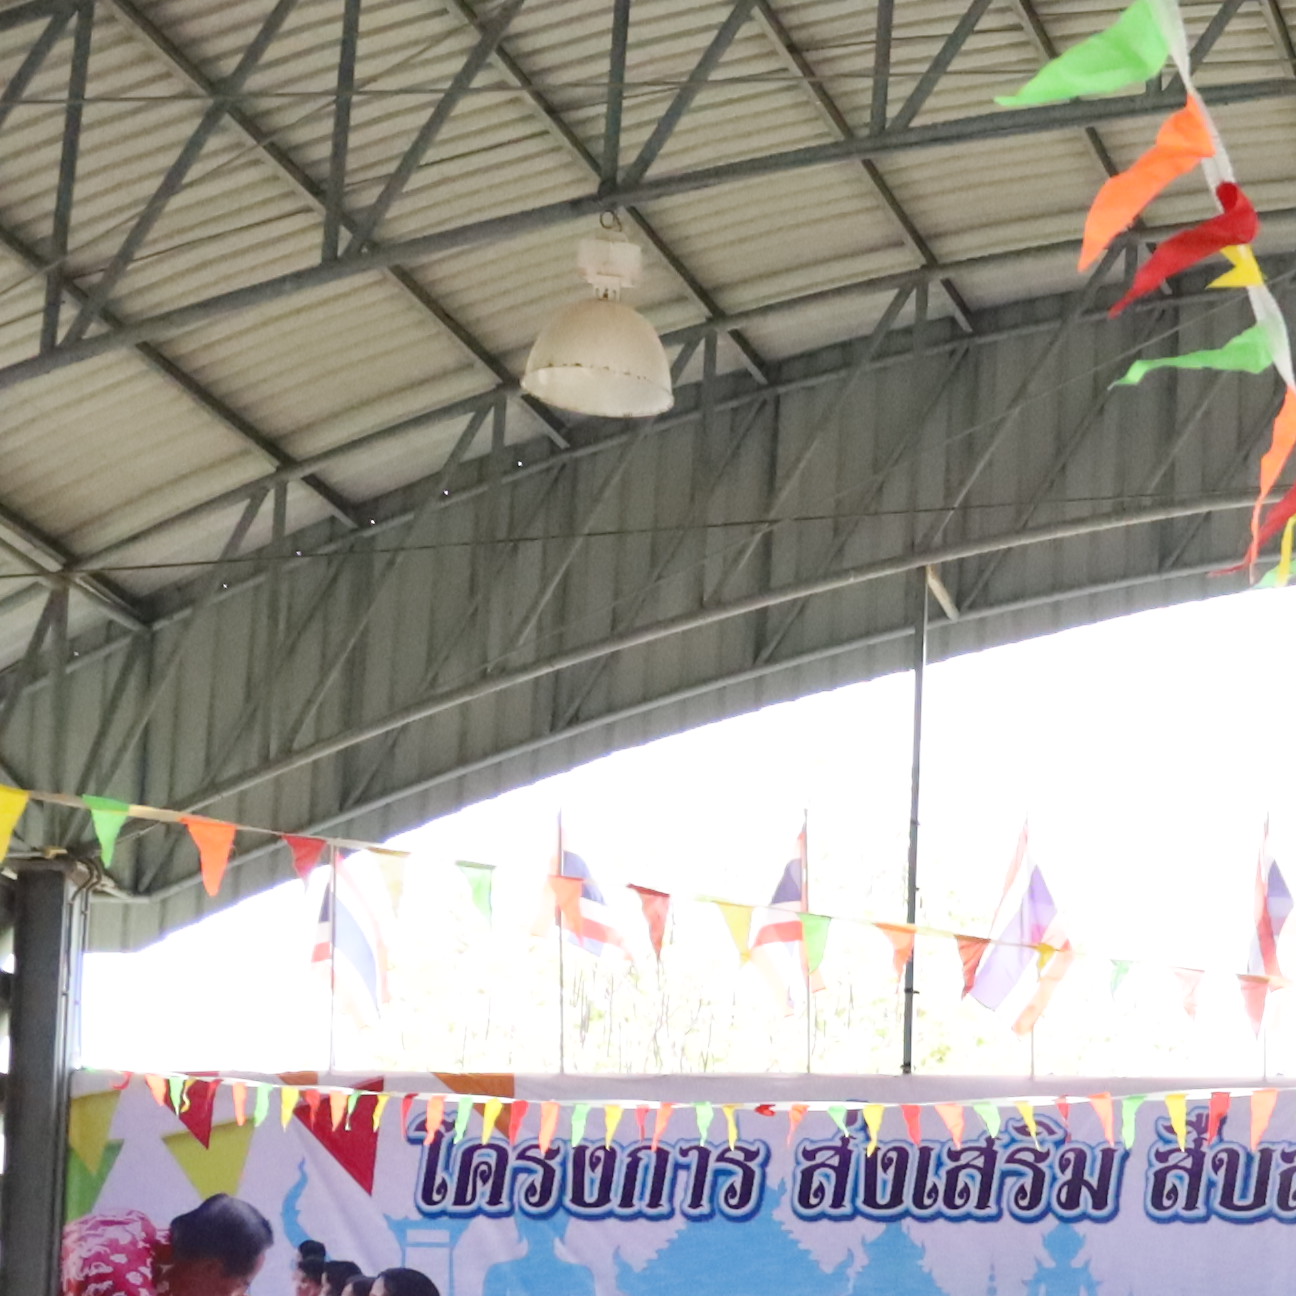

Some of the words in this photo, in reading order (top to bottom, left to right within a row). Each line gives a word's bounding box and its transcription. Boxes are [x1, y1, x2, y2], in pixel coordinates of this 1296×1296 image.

[404, 1109, 762, 1213] โครงการ
[797, 1106, 1115, 1213] ส่งเสริม
